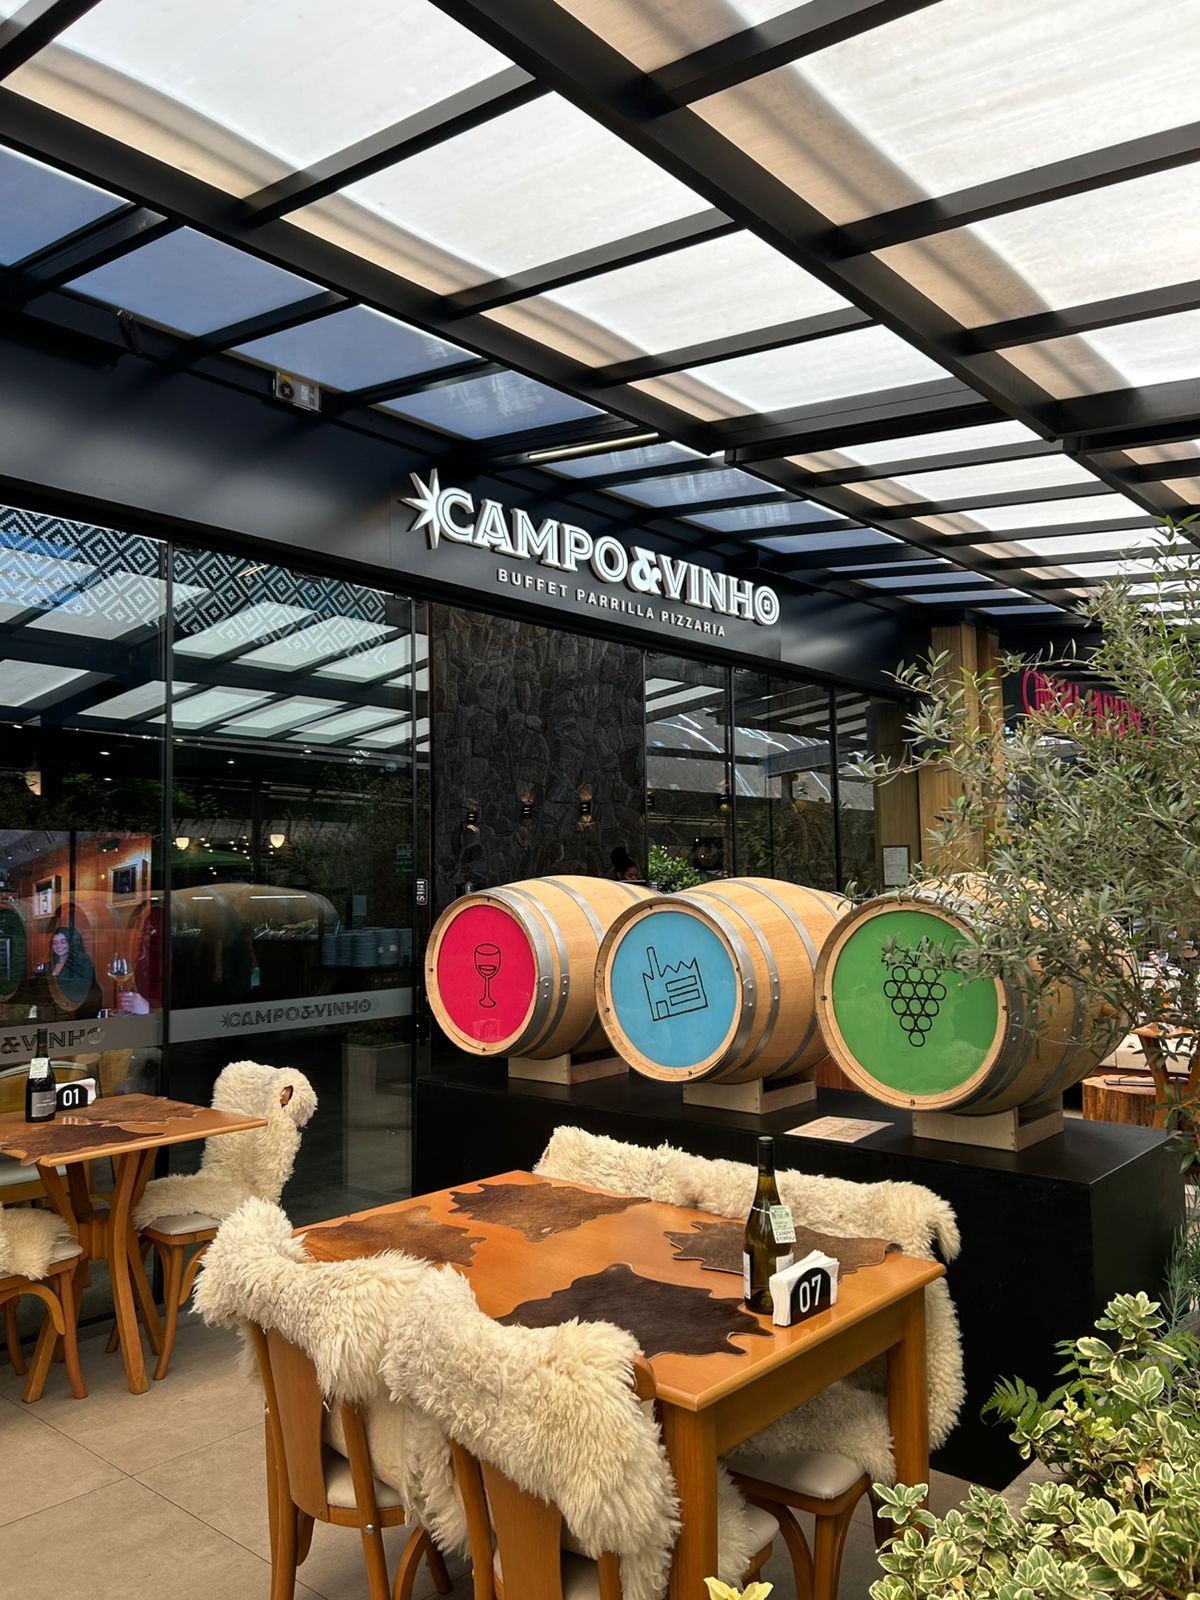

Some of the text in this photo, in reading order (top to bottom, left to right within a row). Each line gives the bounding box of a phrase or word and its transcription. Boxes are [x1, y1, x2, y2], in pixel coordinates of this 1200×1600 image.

[436, 487, 780, 626] CAMPO&VINHO
[497, 568, 726, 637] BUFFET PARRILLA PIZZARIA
[229, 999, 371, 1027] CAMPO&VINHO
[63, 1088, 79, 1106] 01
[799, 1274, 821, 1312] 07
